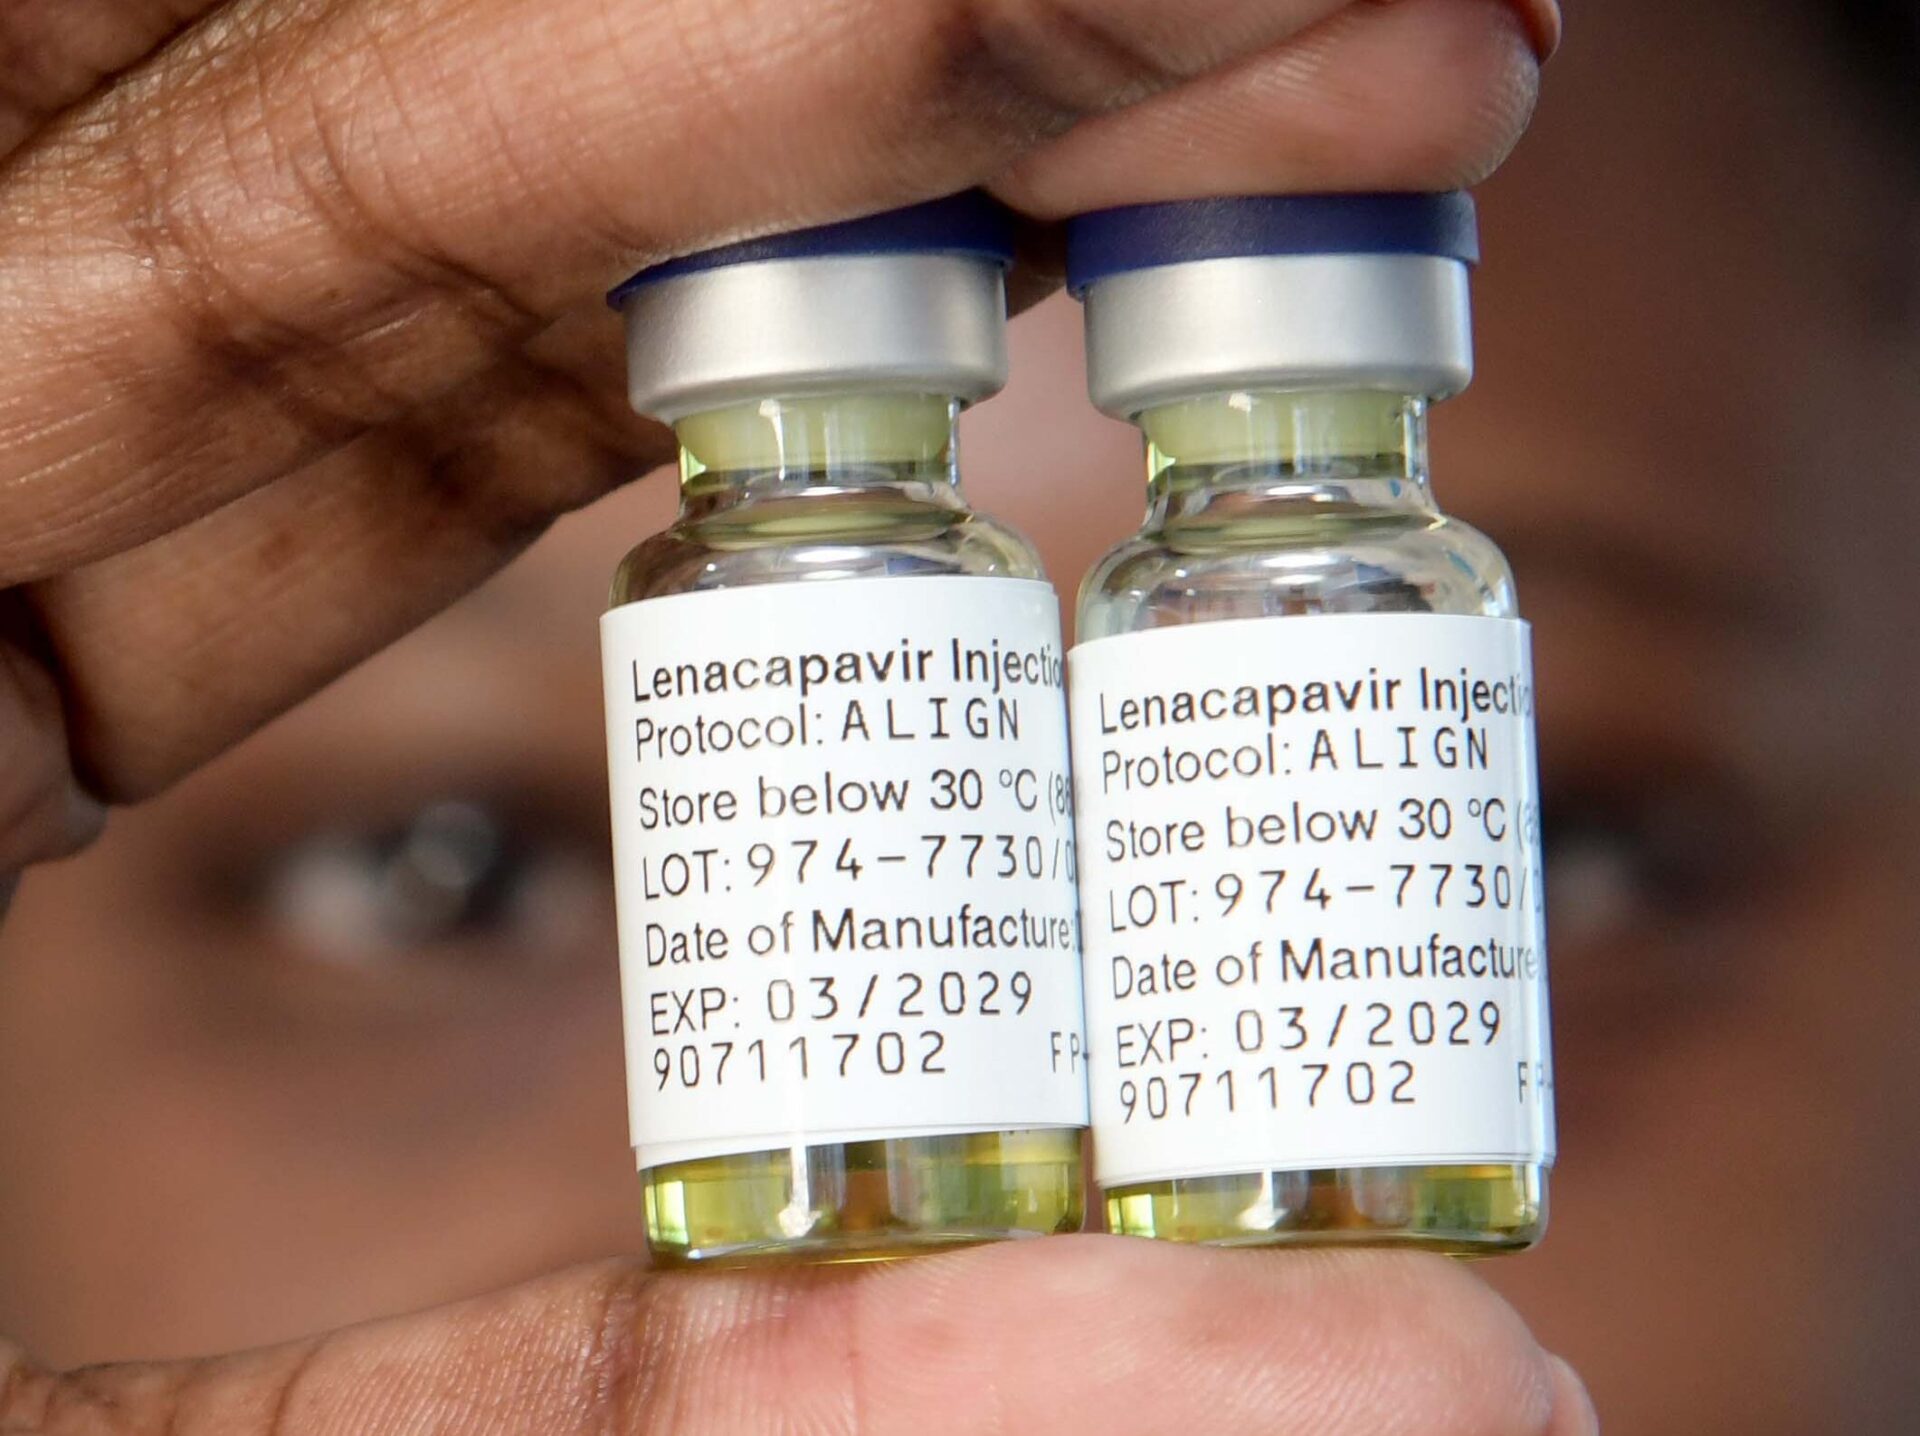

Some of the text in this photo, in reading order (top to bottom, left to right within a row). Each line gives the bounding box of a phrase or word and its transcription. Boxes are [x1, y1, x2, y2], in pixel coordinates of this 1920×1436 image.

[633, 638, 934, 703] Lenacapavir
[1100, 667, 1402, 735] Lenacapavir
[636, 703, 824, 762] Protocol:
[1103, 732, 1290, 794] Protocol:
[640, 787, 737, 830] Store
[759, 771, 909, 818] below
[931, 769, 983, 810] 30
[999, 769, 1037, 811] °C
[1106, 818, 1206, 862] Store
[1226, 802, 1378, 848] below
[1400, 798, 1451, 841] 30
[1468, 798, 1506, 842] °C
[644, 849, 731, 900] LOT:
[1110, 880, 1198, 933] LOT:
[646, 912, 728, 967] Date
[748, 911, 793, 956] of
[1112, 954, 1197, 1000] Date
[1216, 941, 1263, 987] of
[651, 971, 1032, 1036] EXP: 03/2029
[1117, 1001, 1501, 1068] EXP: 03/2029
[654, 1030, 946, 1092] 90711702
[1120, 1060, 1416, 1124] 90711702
